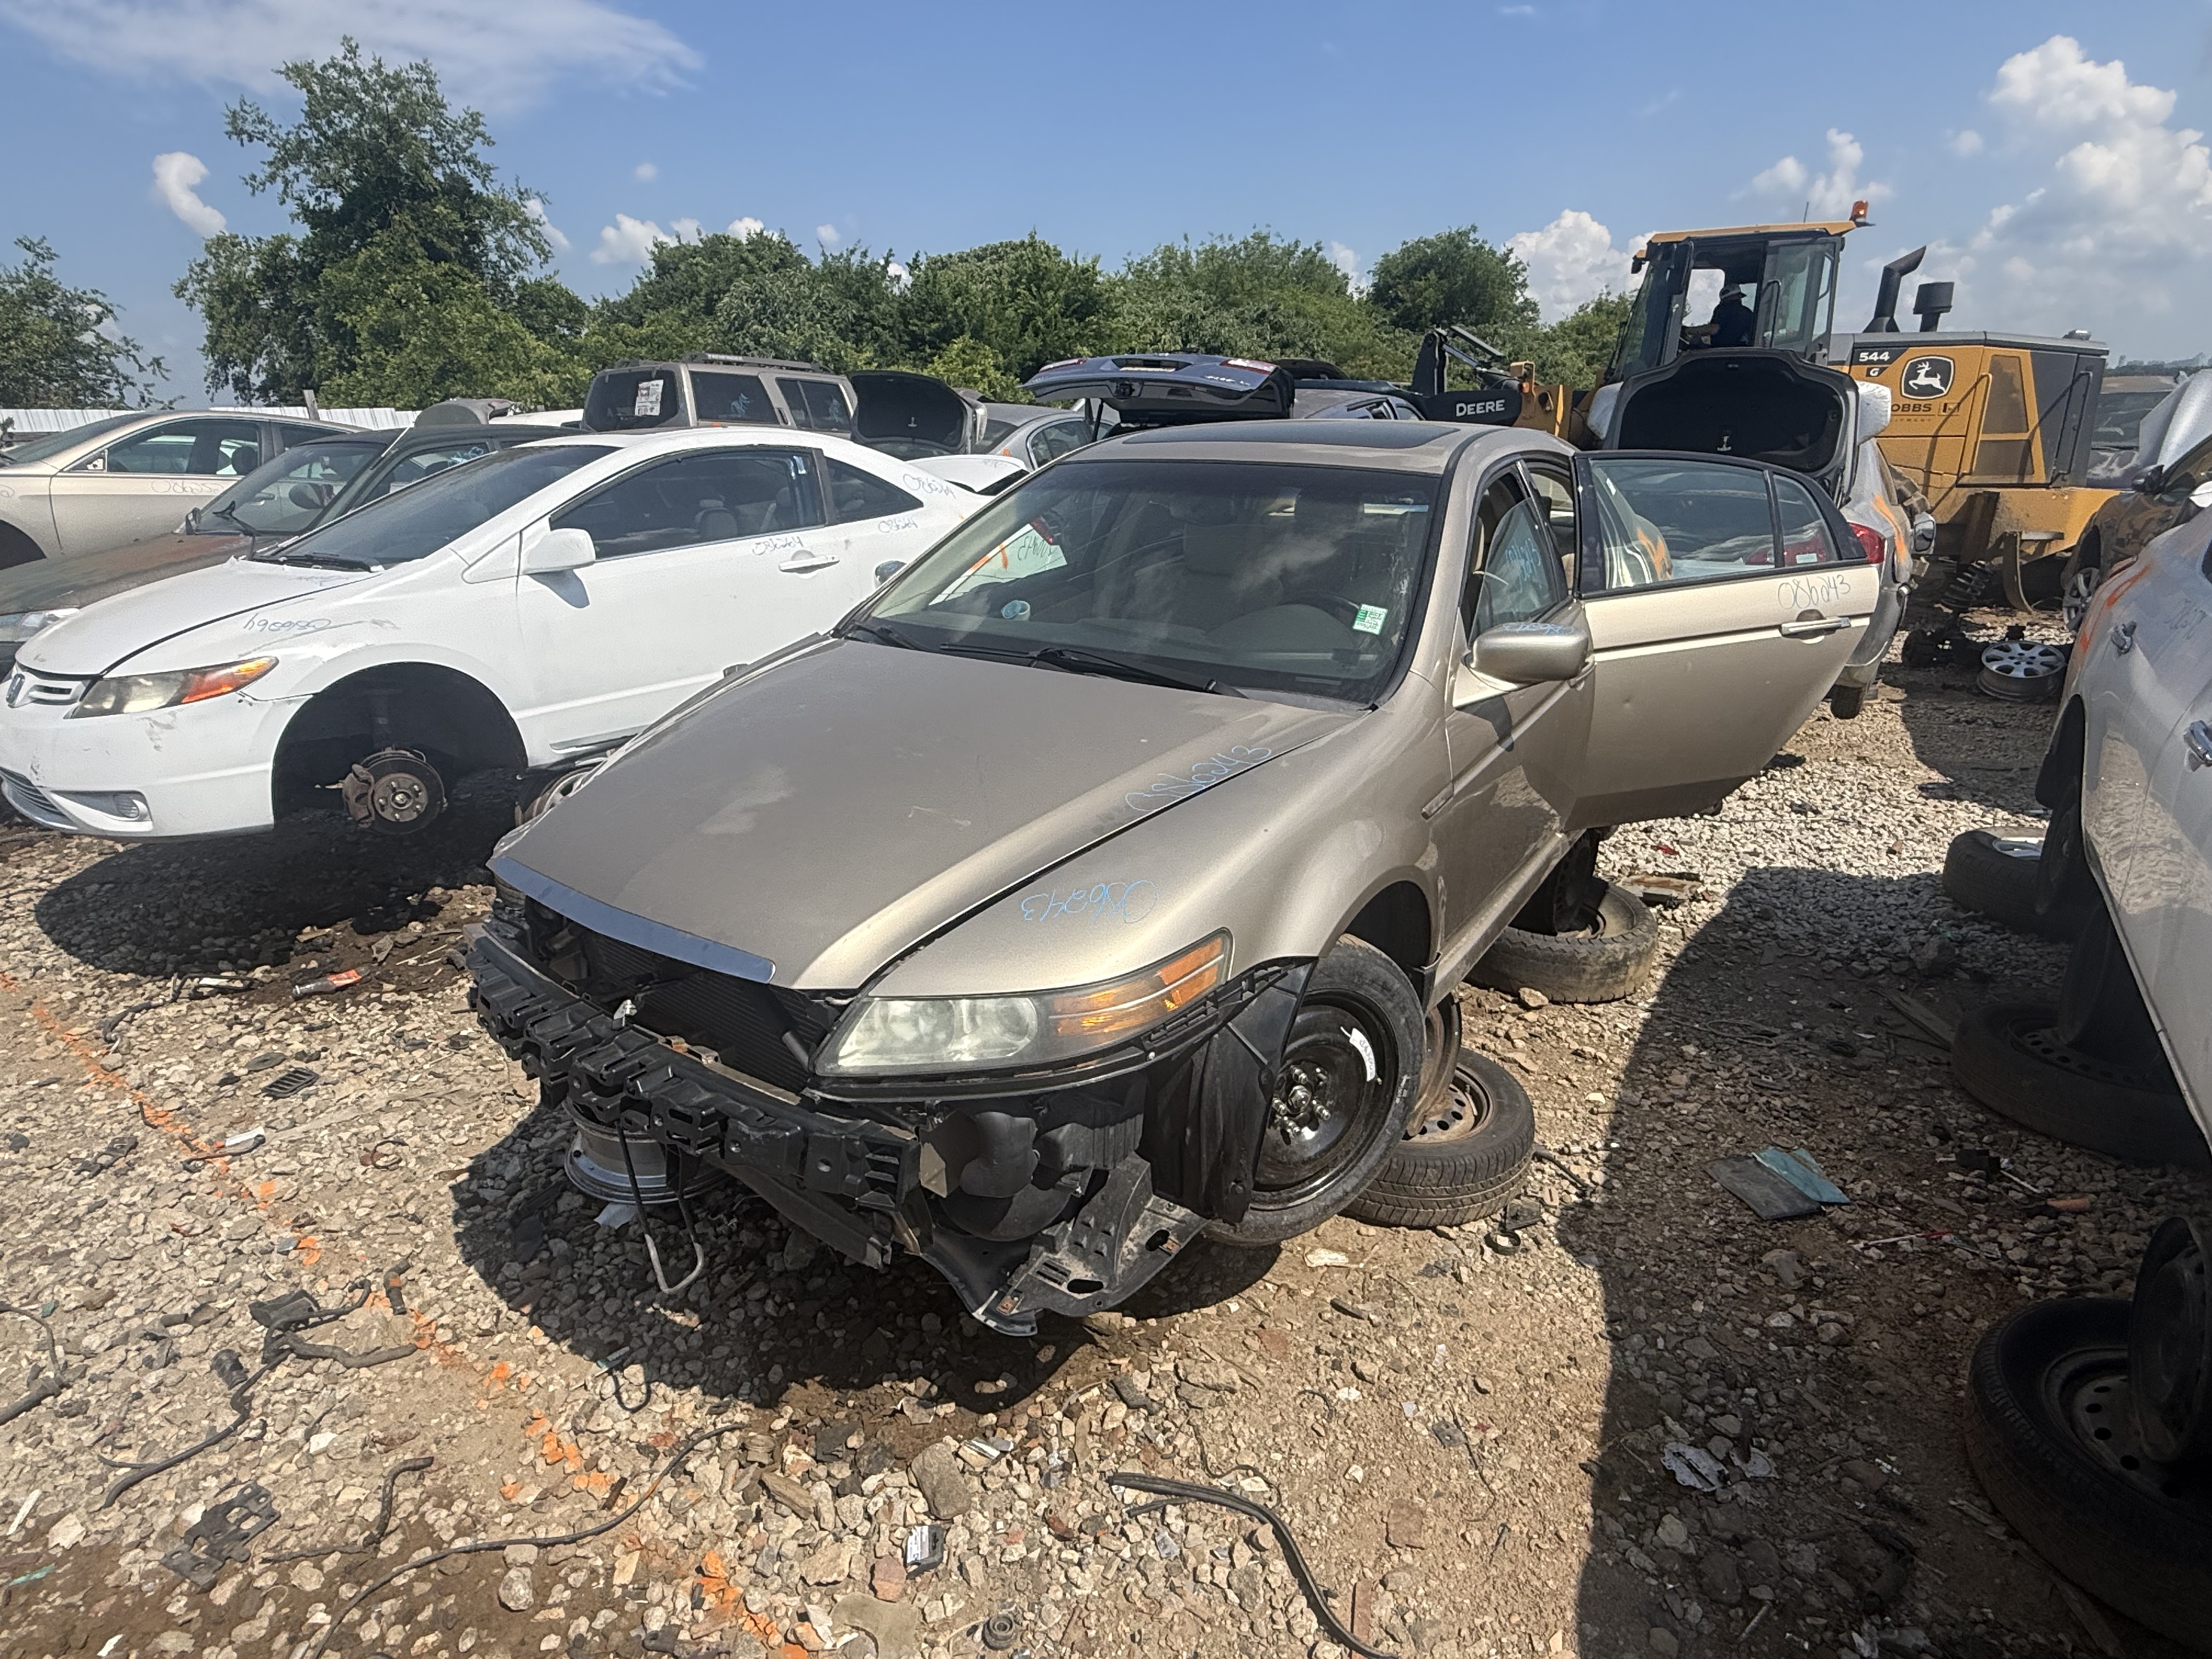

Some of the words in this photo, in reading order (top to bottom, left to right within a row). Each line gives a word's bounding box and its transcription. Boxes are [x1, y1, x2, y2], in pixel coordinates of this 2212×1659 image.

[1859, 351, 1890, 362] 544
[1455, 399, 1505, 417] DEERE
[1891, 403, 1932, 413] OBBS
